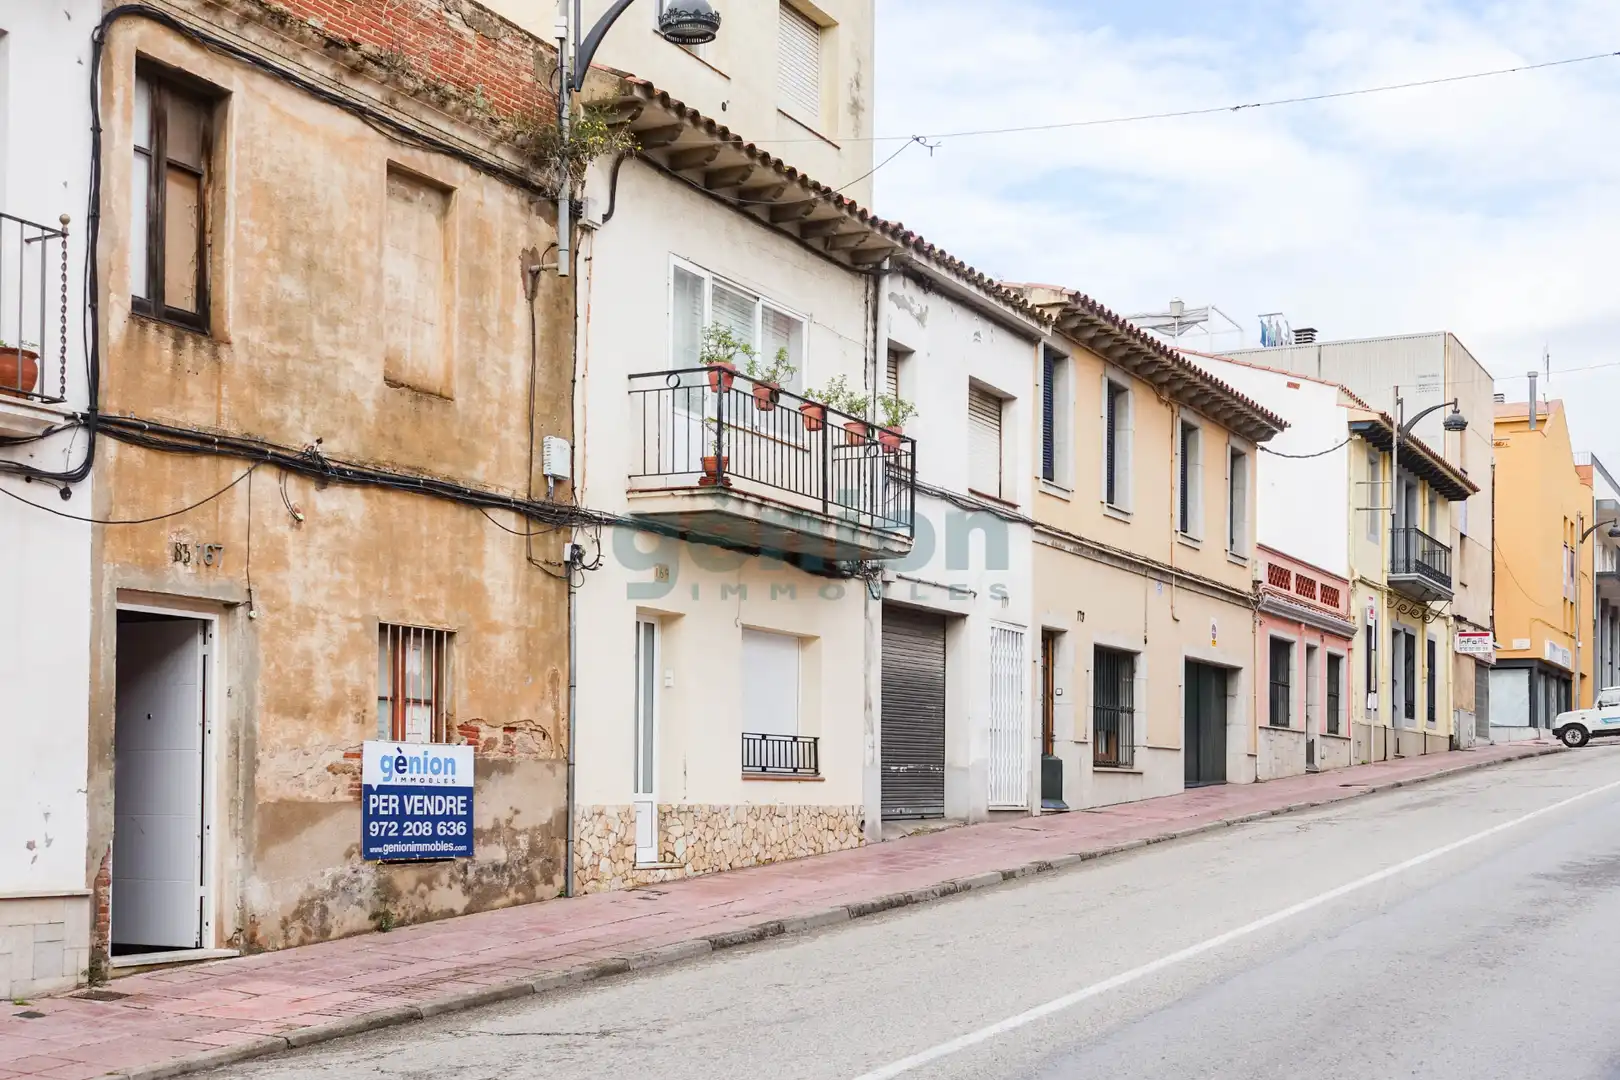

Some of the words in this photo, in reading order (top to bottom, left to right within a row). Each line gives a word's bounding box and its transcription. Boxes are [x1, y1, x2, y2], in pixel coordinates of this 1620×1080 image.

[196, 543, 225, 568] 167
[380, 746, 456, 782] gènion
[369, 794, 399, 815] PER
[404, 795, 468, 816] VENDRE
[369, 821, 399, 837] 972
[403, 821, 433, 837] 208
[437, 821, 467, 837] 636
[369, 840, 467, 855] www.genionimmobles.com
